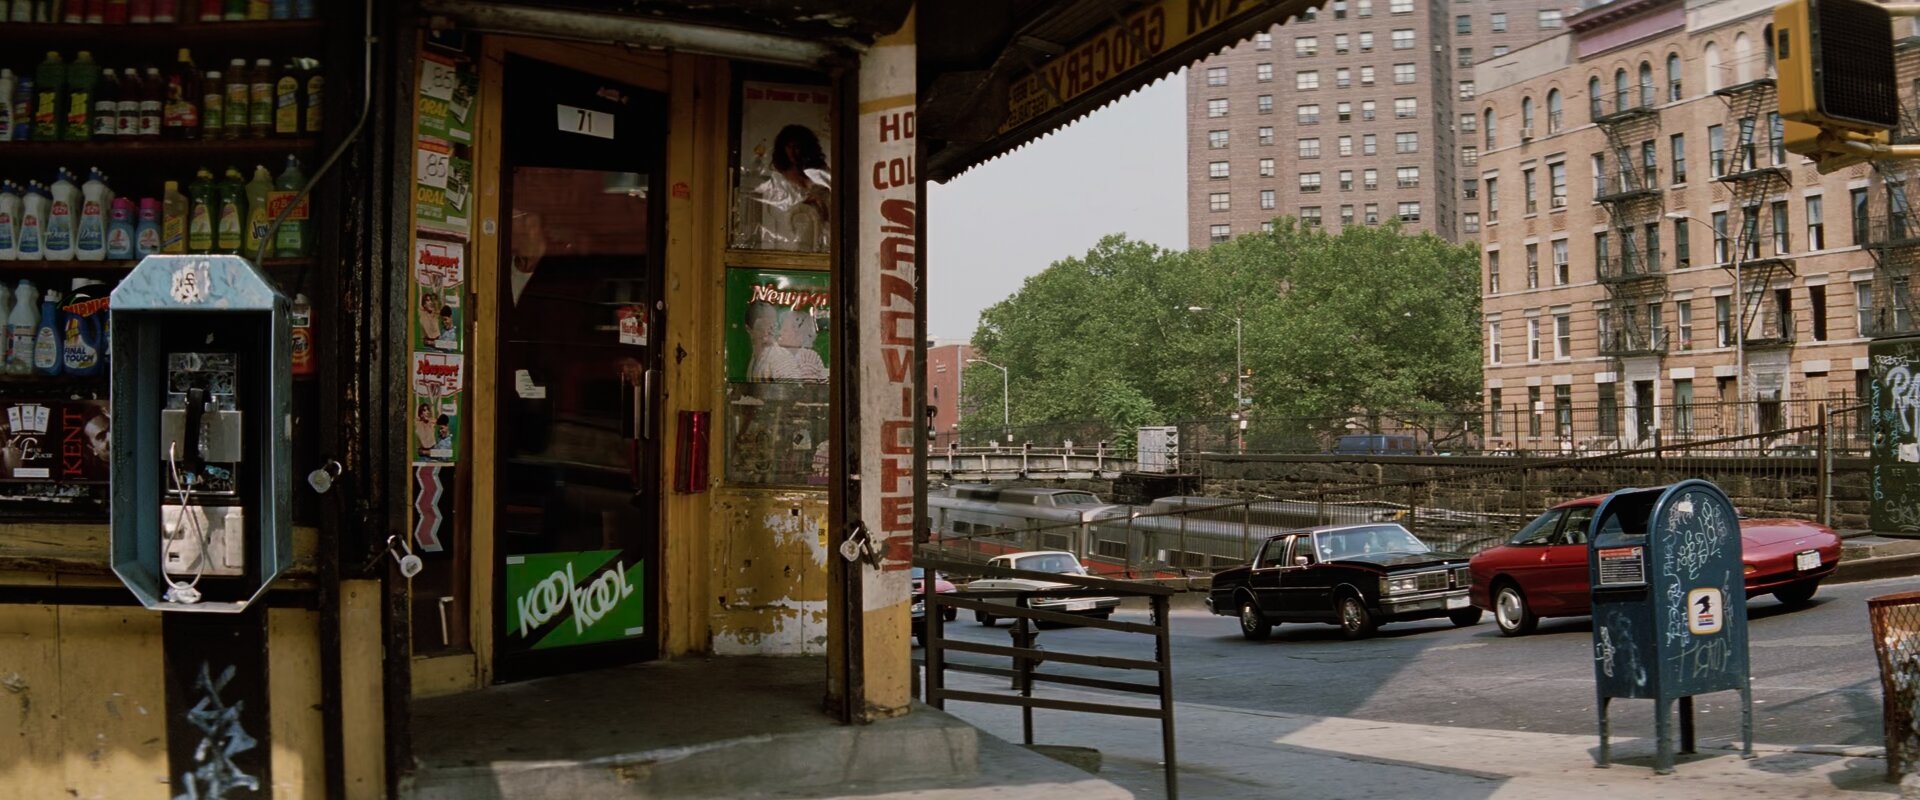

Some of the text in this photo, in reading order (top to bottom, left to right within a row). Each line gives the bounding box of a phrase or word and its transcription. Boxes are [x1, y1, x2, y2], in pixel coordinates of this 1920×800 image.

[577, 109, 592, 133] 71
[418, 249, 459, 270] Newport
[64, 347, 86, 355] FINAL
[65, 353, 94, 363] TOUCH
[416, 359, 459, 379] Newport
[63, 408, 82, 476] KENT
[517, 561, 582, 639] KOOL
[571, 560, 634, 636] KOOL
